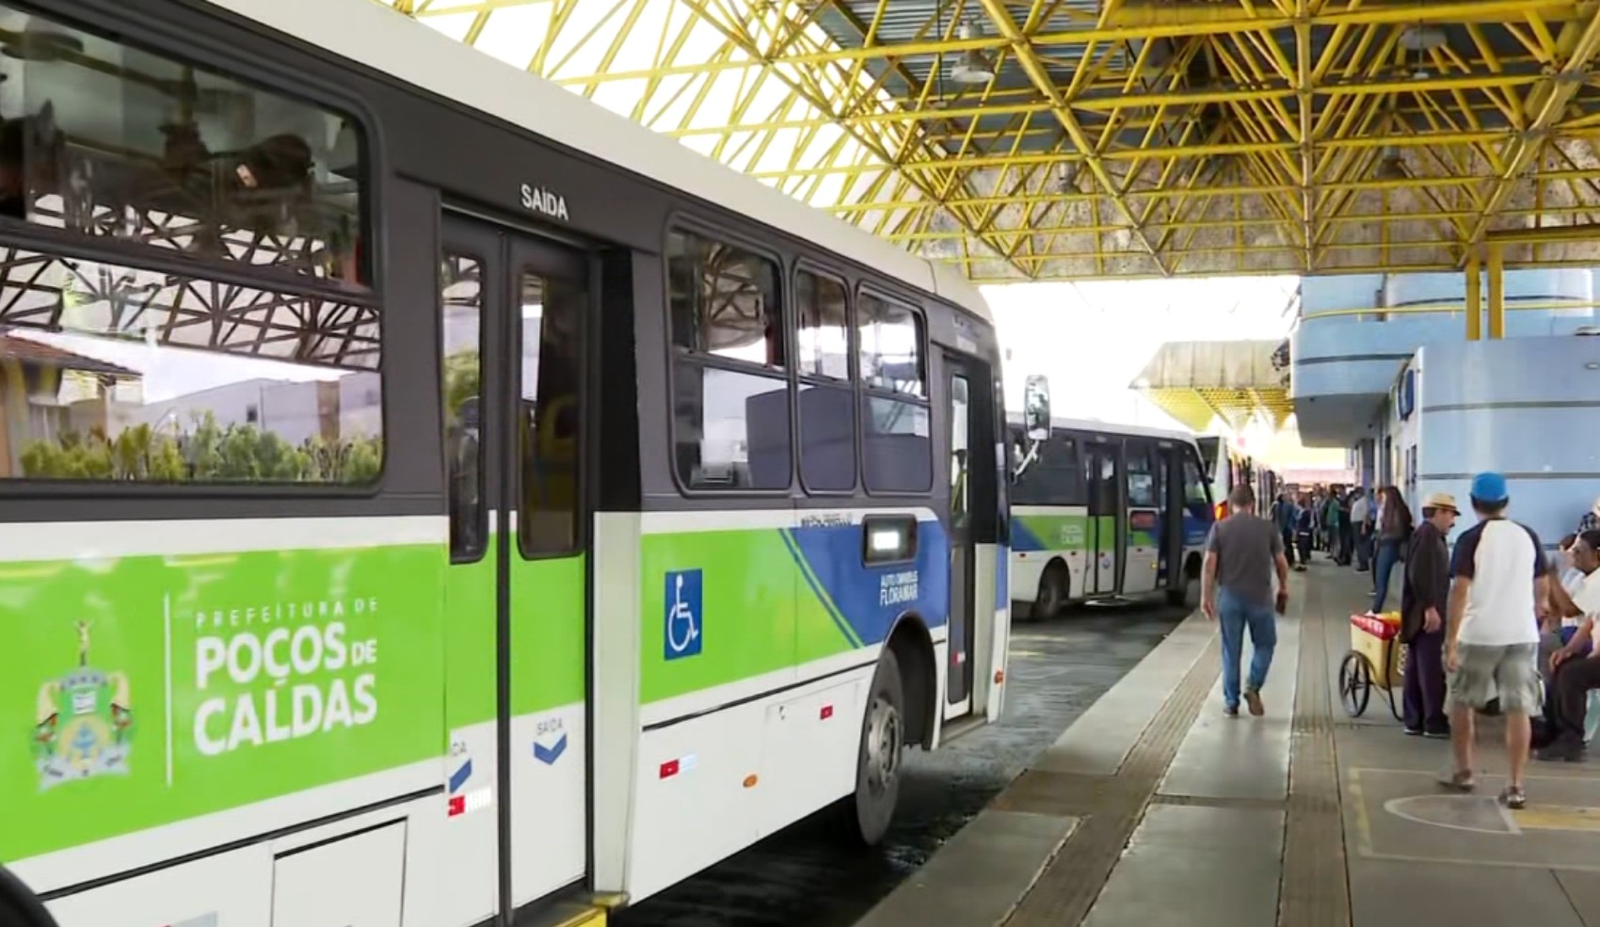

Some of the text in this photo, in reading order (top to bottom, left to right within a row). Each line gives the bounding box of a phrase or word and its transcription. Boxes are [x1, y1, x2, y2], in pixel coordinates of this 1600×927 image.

[520, 182, 569, 221] SAÍDA
[196, 597, 378, 628] PREFEITURA DE
[196, 622, 378, 689] POÇOS DE
[193, 673, 377, 756] CALDAS
